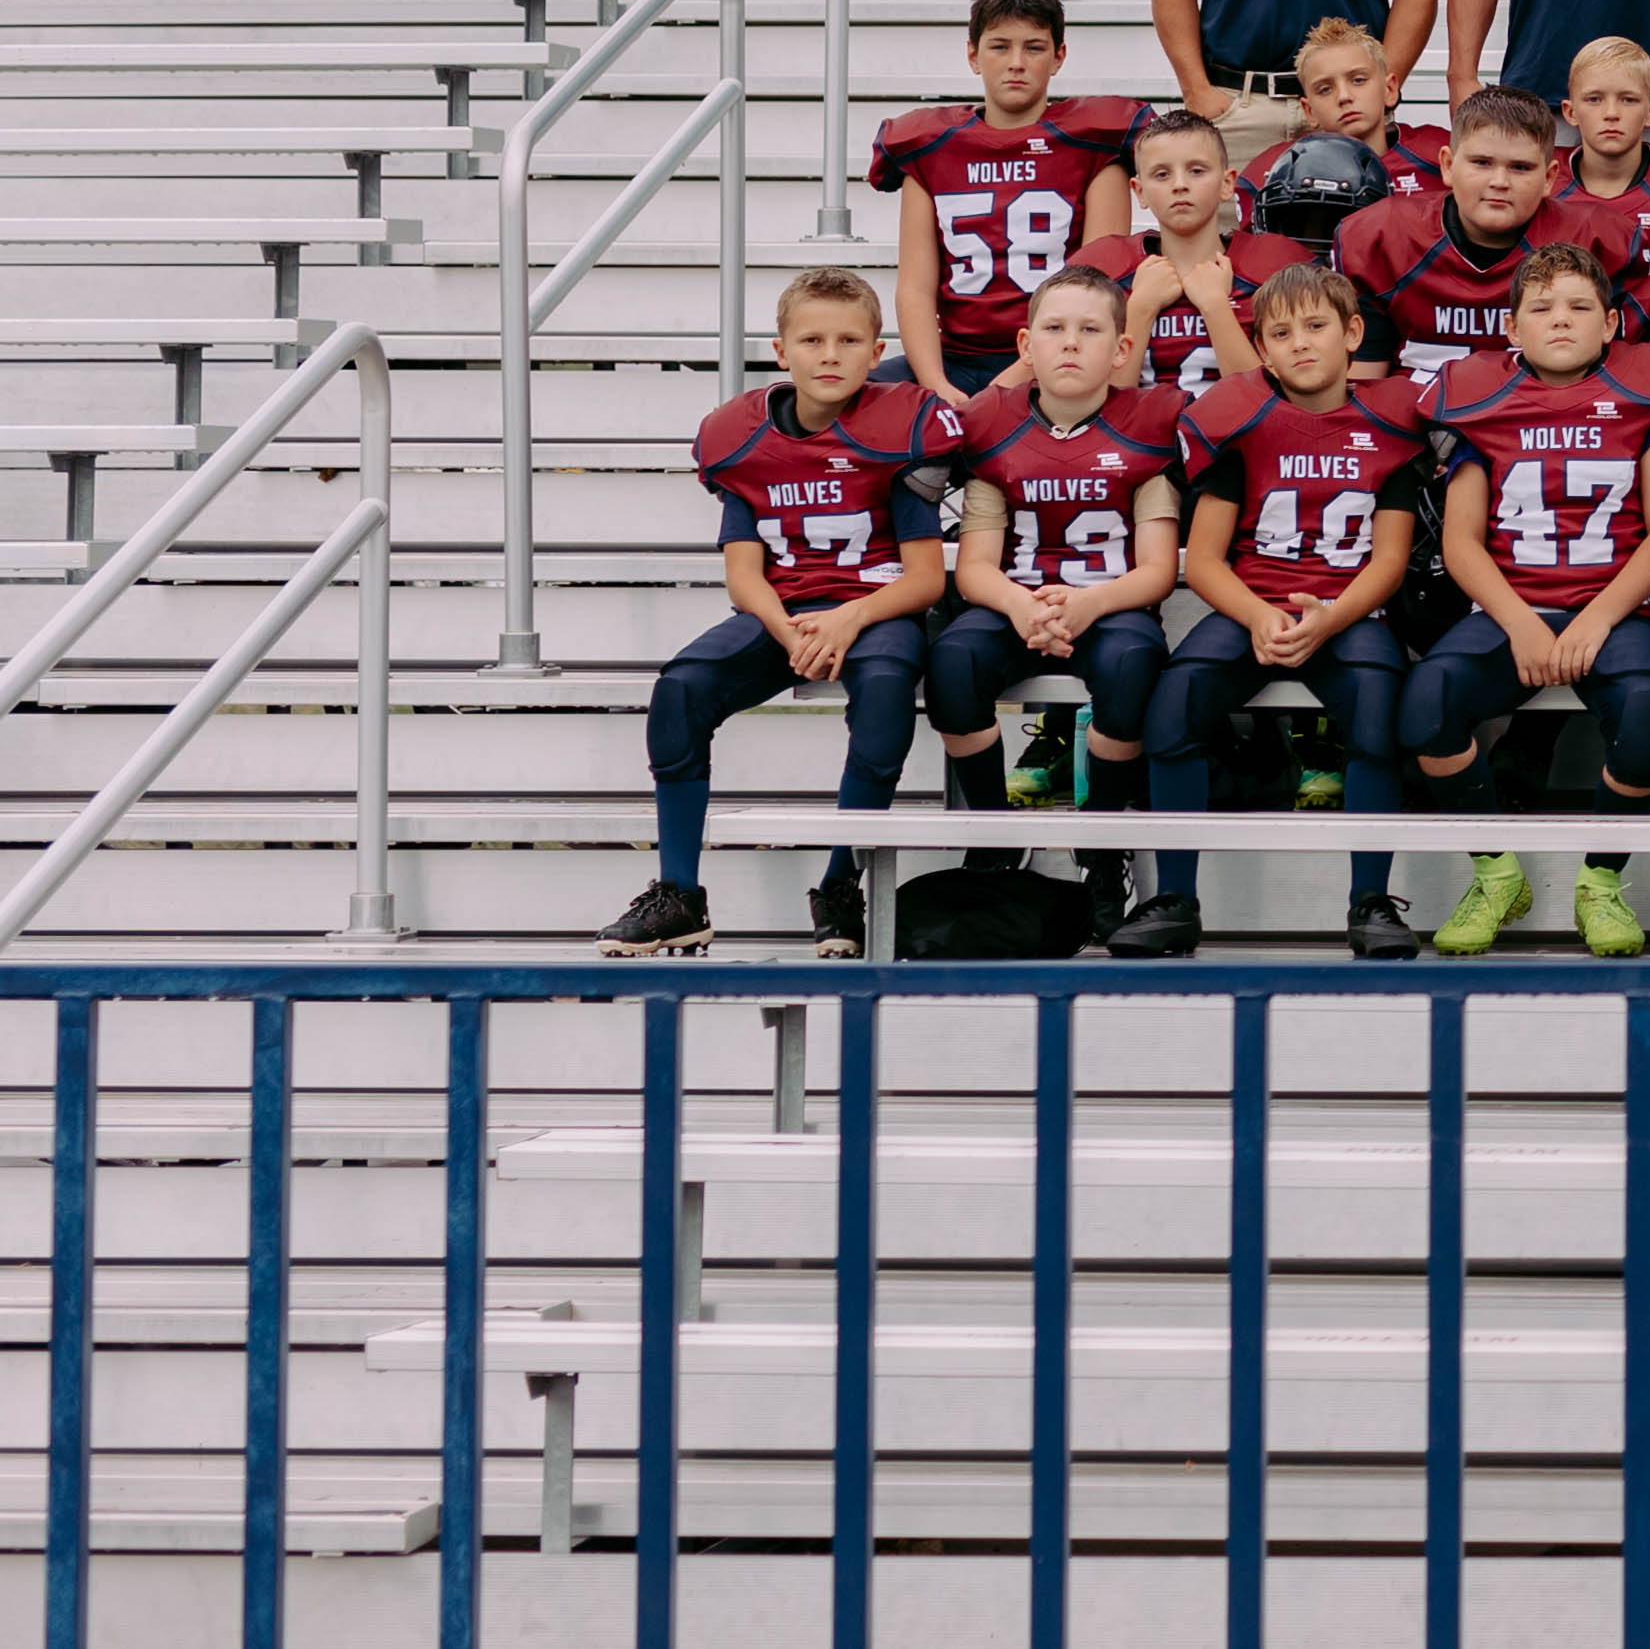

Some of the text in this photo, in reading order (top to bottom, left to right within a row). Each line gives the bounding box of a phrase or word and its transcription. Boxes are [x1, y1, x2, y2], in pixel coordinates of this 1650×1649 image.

[967, 160, 1037, 184] WOLVES
[934, 190, 1073, 295] 58
[1434, 306, 1509, 336] WOLVE
[1519, 425, 1603, 451] WOLVES
[1278, 454, 1360, 481] WOLVES
[766, 479, 843, 508] WOLVES
[1022, 477, 1108, 503] WOLVES
[1496, 460, 1637, 566] 47
[756, 510, 873, 567] 17
